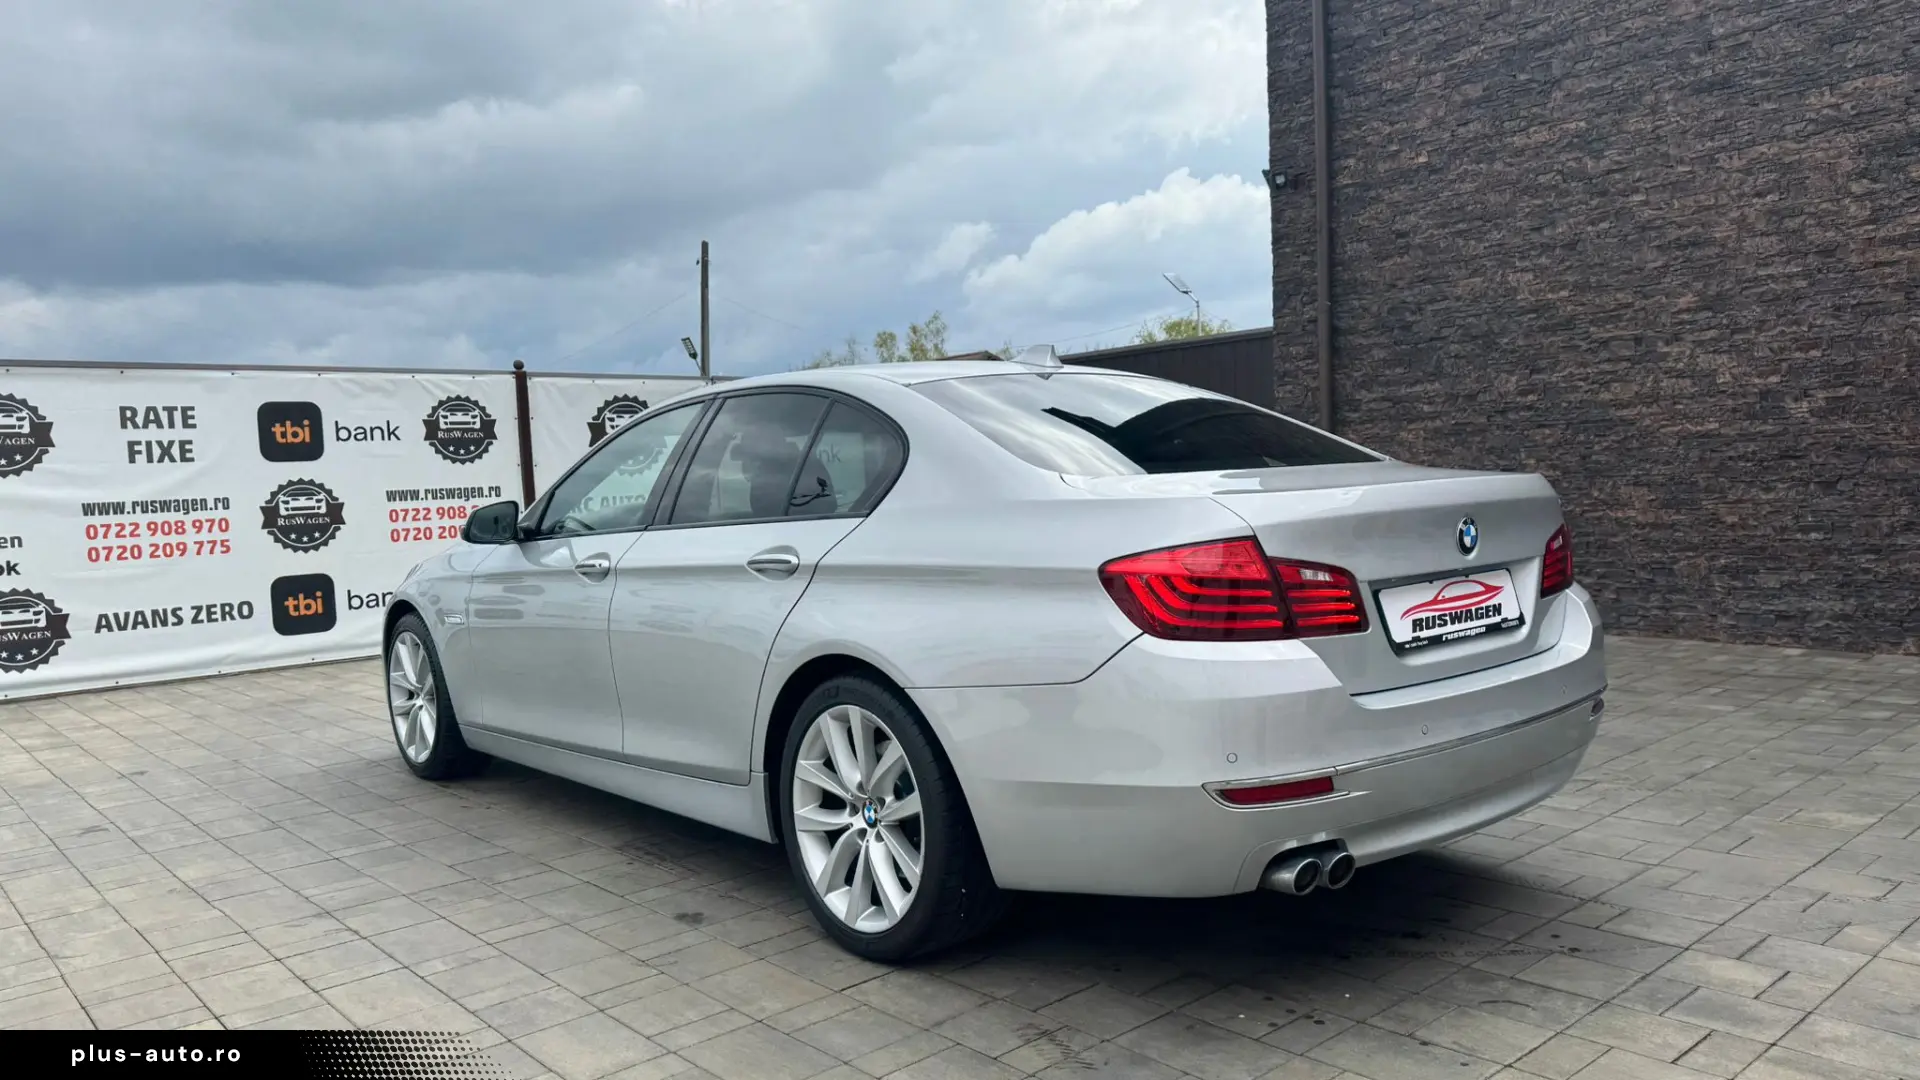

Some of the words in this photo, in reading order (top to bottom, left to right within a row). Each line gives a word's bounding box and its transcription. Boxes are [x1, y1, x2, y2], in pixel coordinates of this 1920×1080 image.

[119, 405, 197, 430] RATE
[0, 436, 35, 445] AGEN
[271, 419, 311, 443] tbi
[334, 420, 401, 442] bank
[127, 439, 195, 464] FIXE
[386, 486, 502, 502] www.ruswagen.ro
[81, 497, 231, 516] www.ruswagen.ro
[389, 507, 432, 523] 0722
[436, 505, 468, 520] 908
[85, 521, 141, 541] 0722
[146, 519, 187, 537] 908
[191, 517, 230, 534] 970
[390, 526, 433, 542] 0720
[87, 544, 143, 563] 0720
[149, 541, 188, 559] 209
[193, 539, 232, 556] 775
[284, 591, 324, 616] tbi
[94, 606, 184, 634] AVANS
[190, 600, 254, 625] ZERO
[1411, 602, 1503, 634] RUSWAGEN
[1442, 626, 1487, 641] ruswagen
